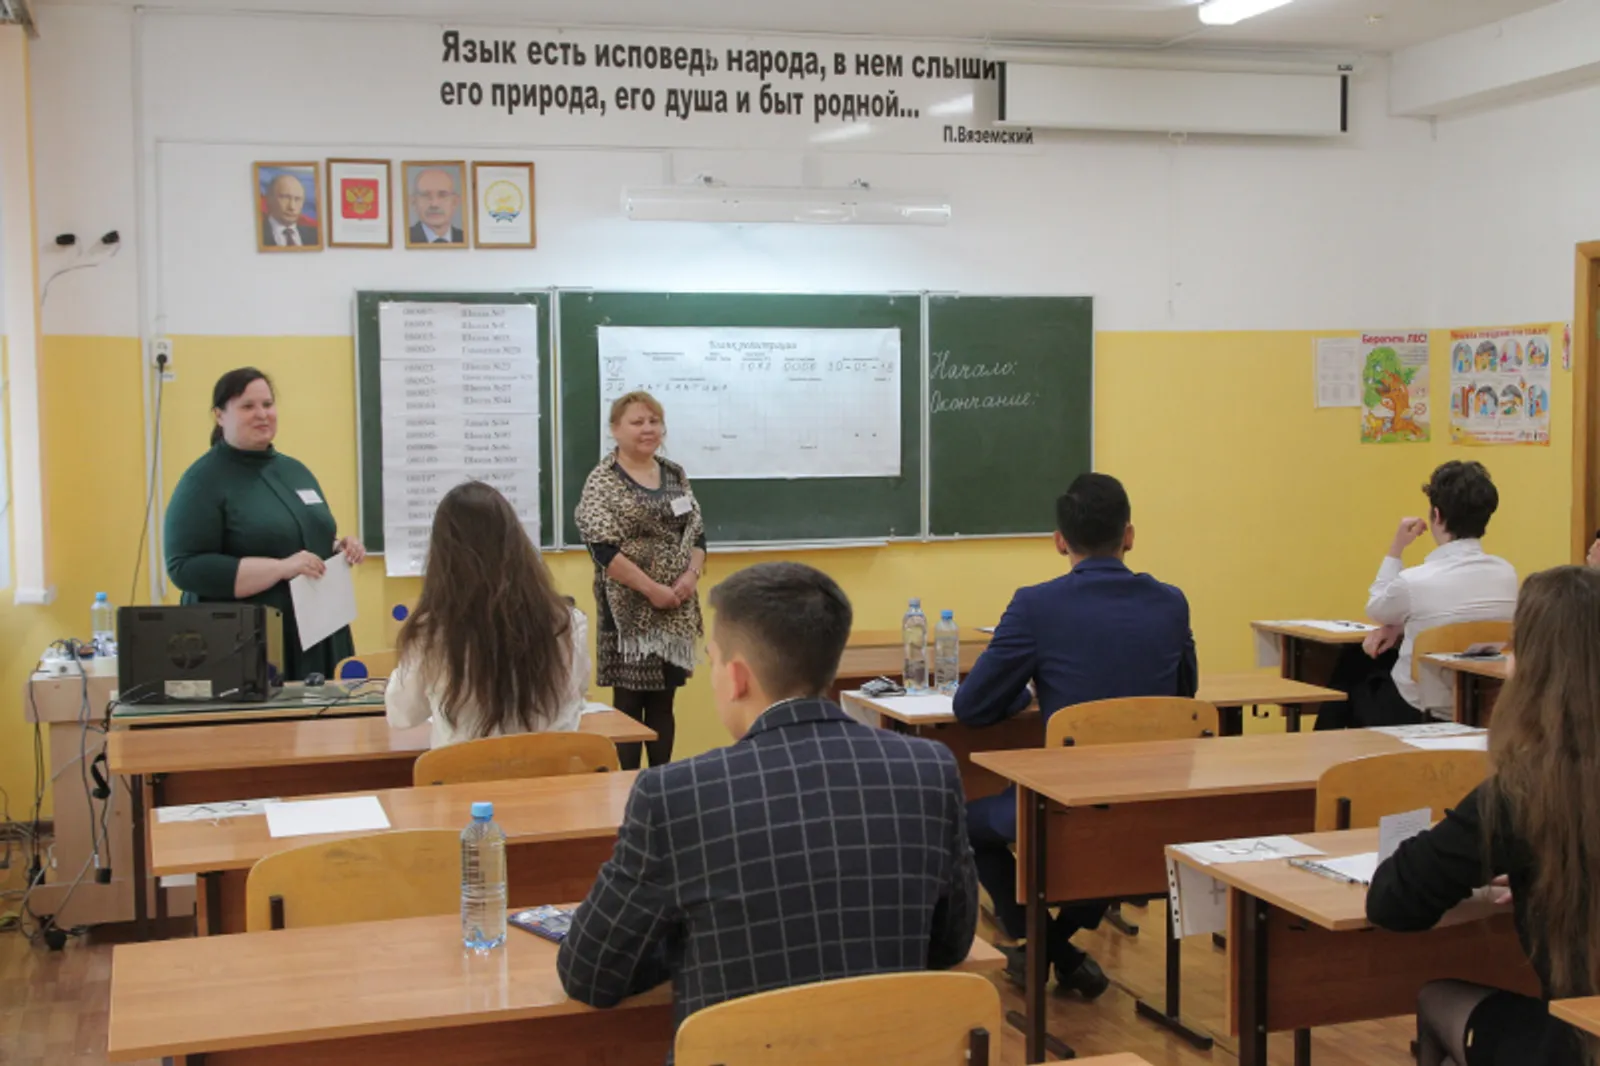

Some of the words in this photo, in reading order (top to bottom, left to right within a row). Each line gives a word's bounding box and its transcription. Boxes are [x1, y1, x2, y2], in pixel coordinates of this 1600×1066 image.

[442, 30, 517, 64] Язык
[527, 41, 586, 66] есть
[595, 44, 719, 77] исповедь
[726, 49, 826, 81] народа,
[833, 52, 847, 75] в
[855, 53, 903, 77] нем
[440, 81, 483, 106] его
[491, 82, 606, 116] природа,
[614, 86, 655, 111] его
[665, 88, 728, 120] душа
[736, 90, 750, 113] и
[759, 83, 804, 115] быт
[814, 89, 919, 124] родной...
[943, 125, 1034, 145] П.Вяземский
[930, 349, 1018, 380] Начало:
[930, 389, 1040, 414] Окончание:
